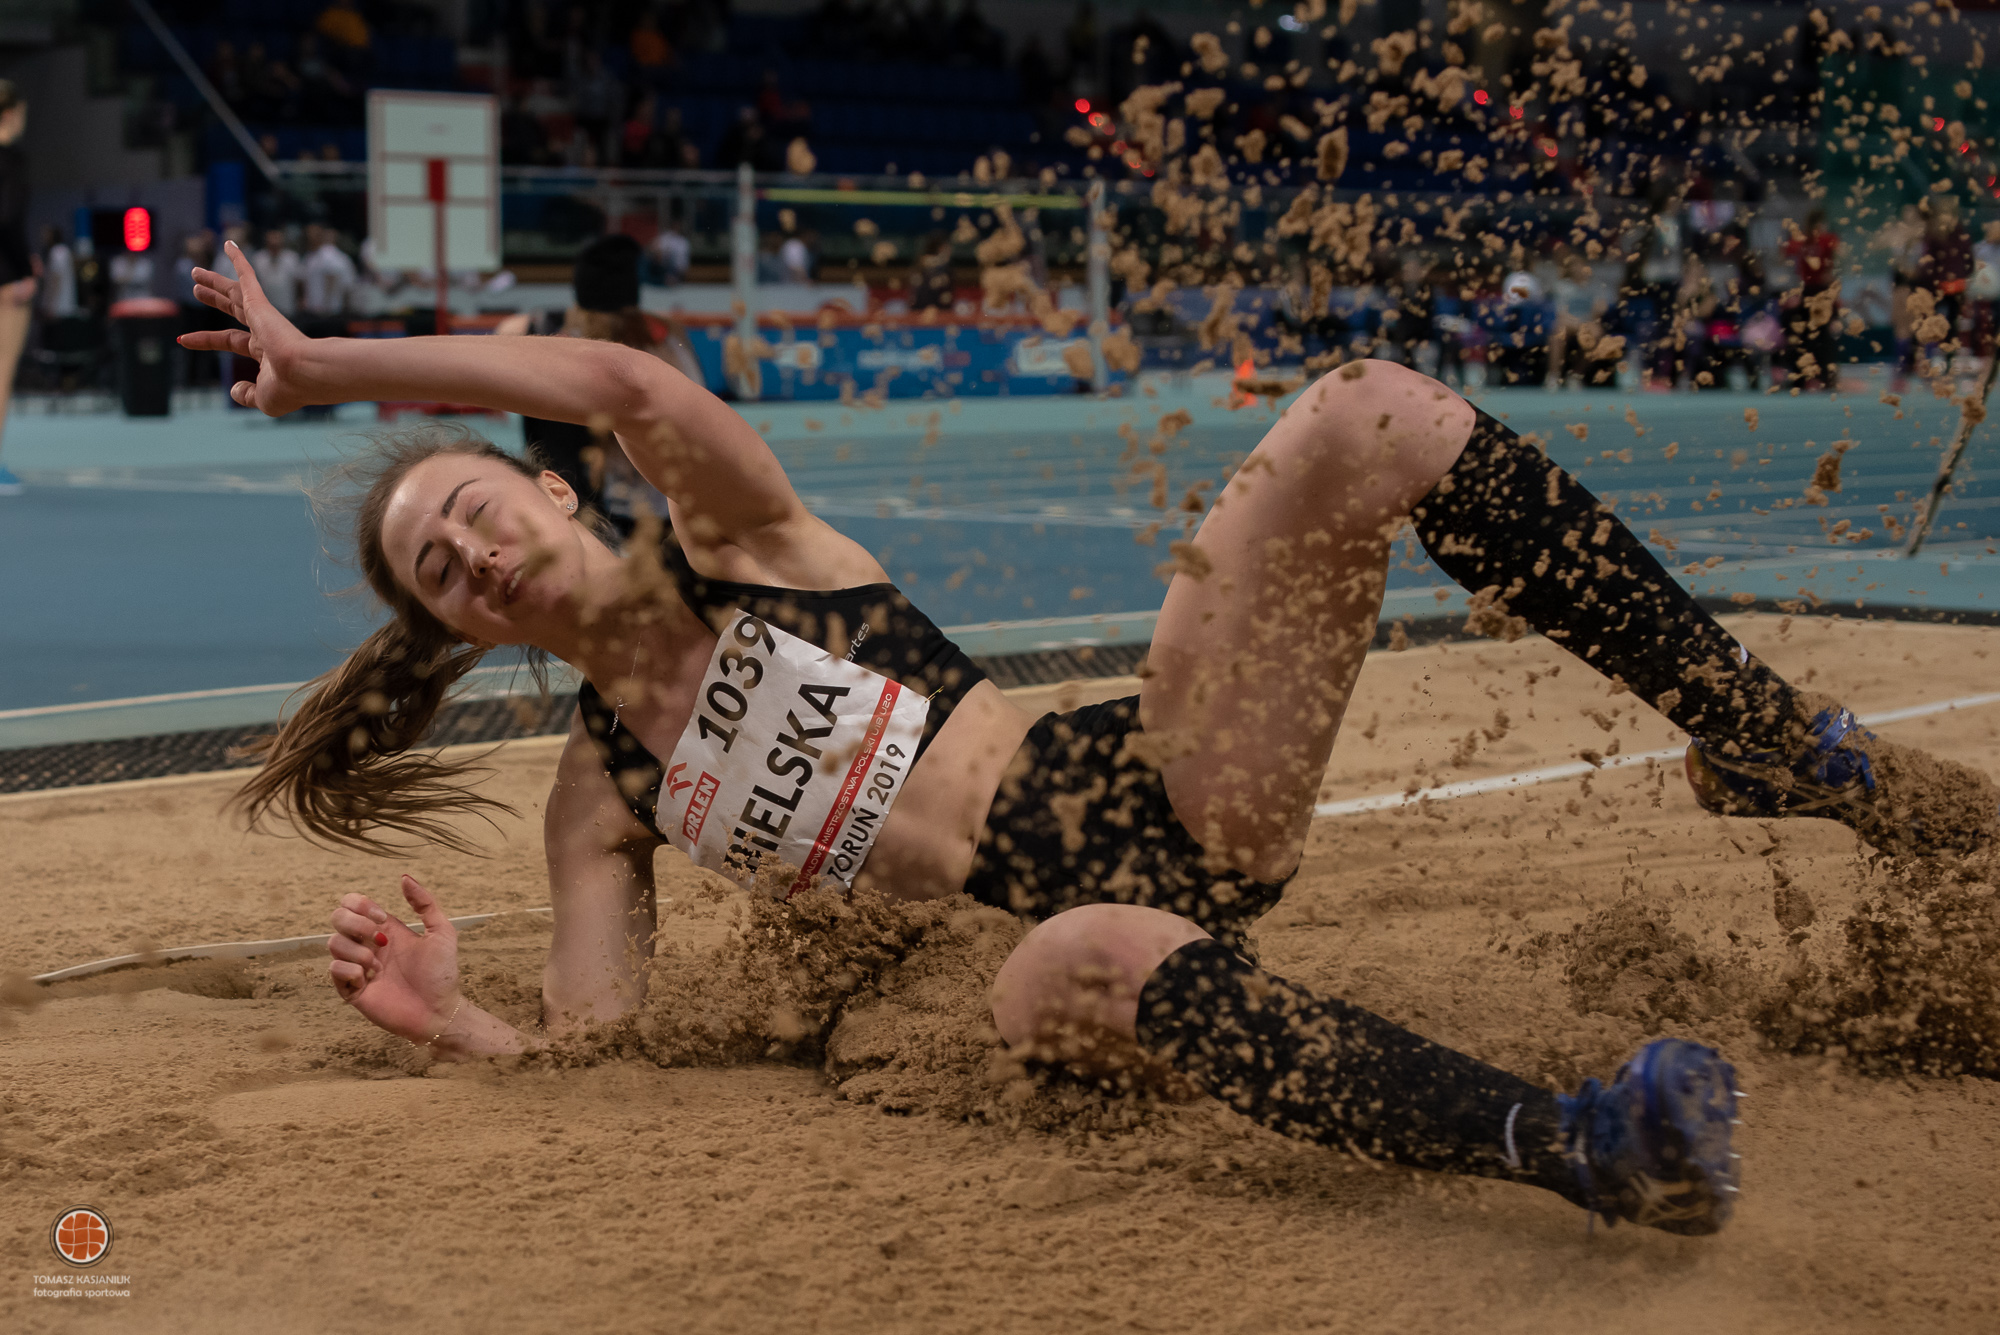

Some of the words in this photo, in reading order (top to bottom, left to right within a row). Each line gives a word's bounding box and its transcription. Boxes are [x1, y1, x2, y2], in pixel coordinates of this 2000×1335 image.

[697, 615, 777, 754] 1039
[685, 776, 717, 840] ORLEN
[803, 843, 826, 881] HALOWE
[822, 775, 859, 845] MISTRZOSTWA
[854, 738, 876, 775] POLSKI
[871, 717, 884, 737] U18
[881, 693, 893, 716] U20
[827, 807, 880, 882] TORUŃ
[866, 743, 906, 806] 2019
